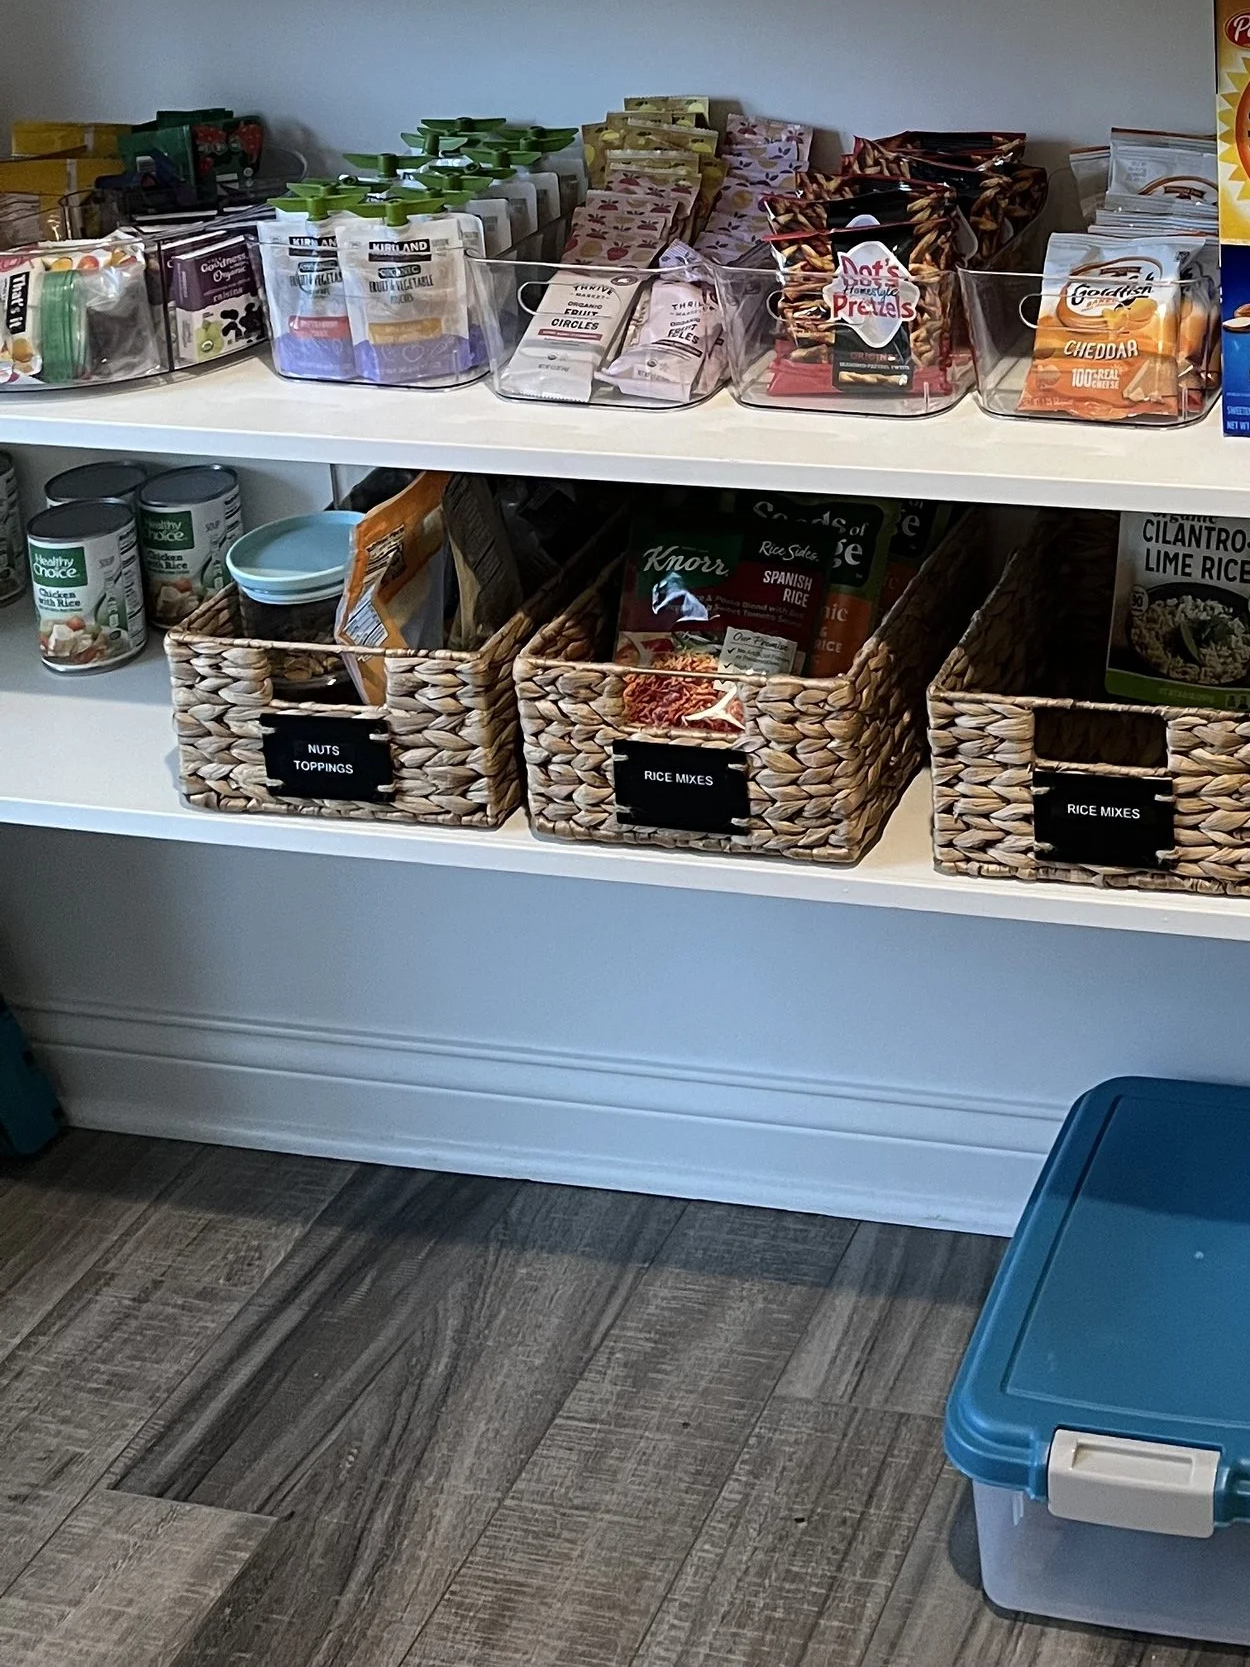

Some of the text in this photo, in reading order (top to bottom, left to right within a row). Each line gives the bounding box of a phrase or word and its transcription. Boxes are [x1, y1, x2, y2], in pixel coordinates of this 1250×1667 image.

[1071, 279, 1154, 308] Goldfish
[832, 295, 915, 319] Pretzels
[551, 317, 600, 331] CIRCLES
[1064, 339, 1139, 361] CHEDDAR
[1227, 421, 1239, 430] NET
[1143, 518, 1247, 553] CILANTRO
[759, 540, 817, 562] Rice Sides
[34, 552, 75, 569] Healthy
[643, 545, 727, 577] Knorr
[1145, 548, 1194, 578] LIME
[33, 564, 77, 579] Choice
[763, 570, 813, 592] SPANISH
[39, 588, 76, 600] Chicken
[783, 590, 810, 608] RICE
[38, 597, 81, 609] with Rice
[733, 632, 790, 651] Our Promise
[307, 743, 340, 756] NUTS
[293, 759, 354, 775] TOPPINGS
[644, 770, 714, 786] RICE MIXES
[1067, 803, 1141, 820] RICE MIXES
